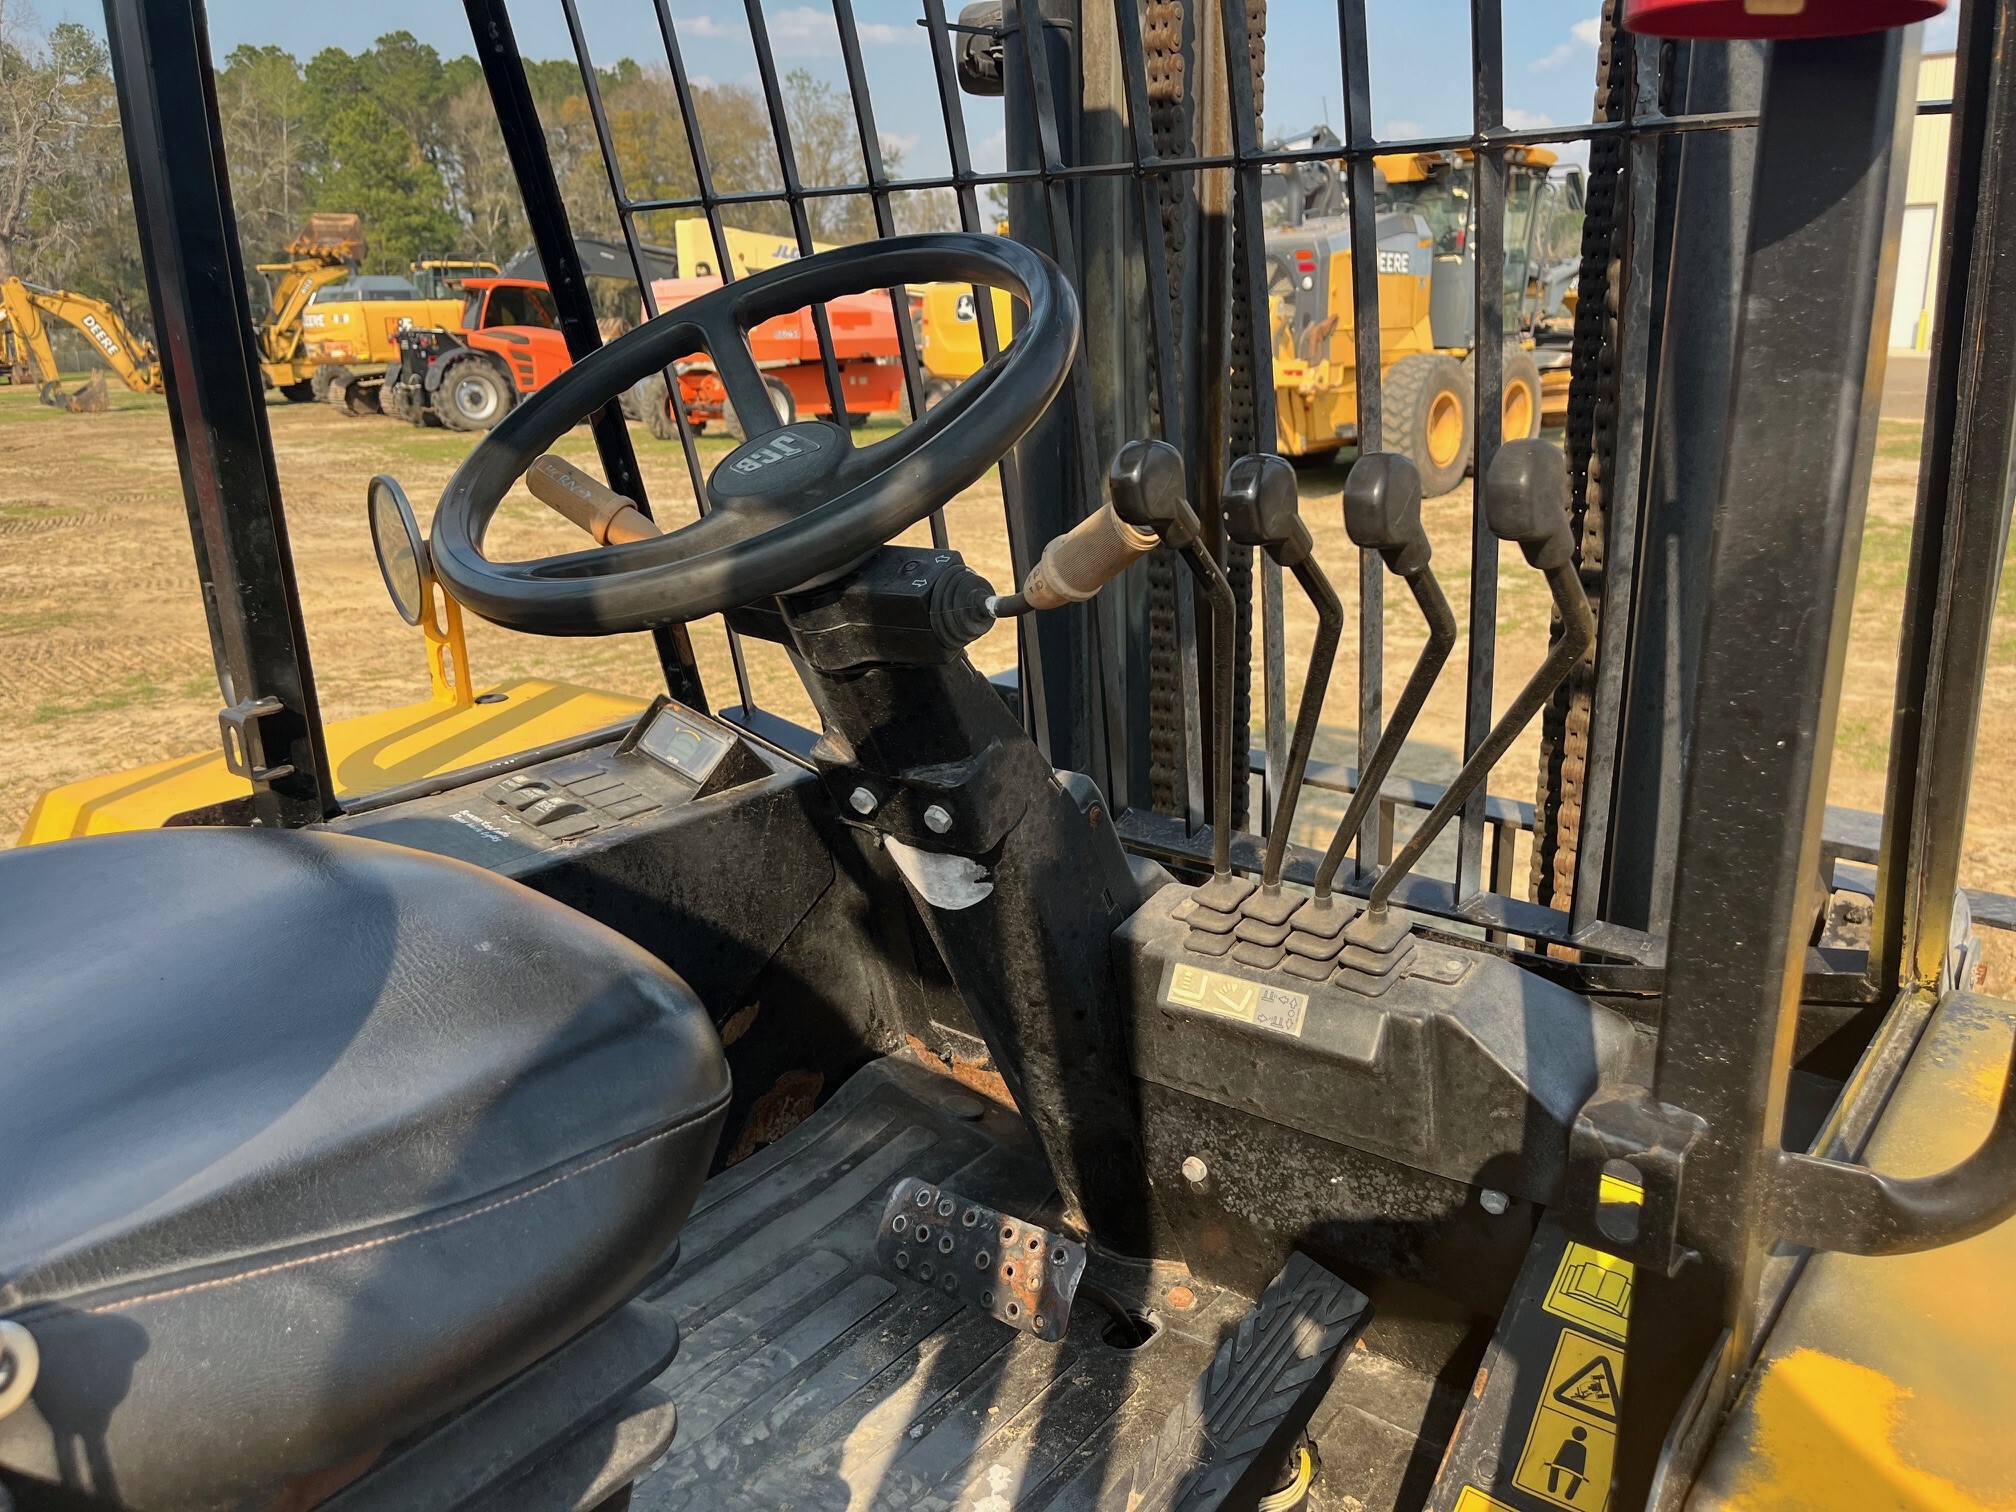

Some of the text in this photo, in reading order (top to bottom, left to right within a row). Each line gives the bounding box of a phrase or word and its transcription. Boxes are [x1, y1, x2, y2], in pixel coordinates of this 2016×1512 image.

[1379, 251, 1410, 273] EERE
[82, 315, 119, 355] DEERE
[736, 435, 803, 472] JCB
